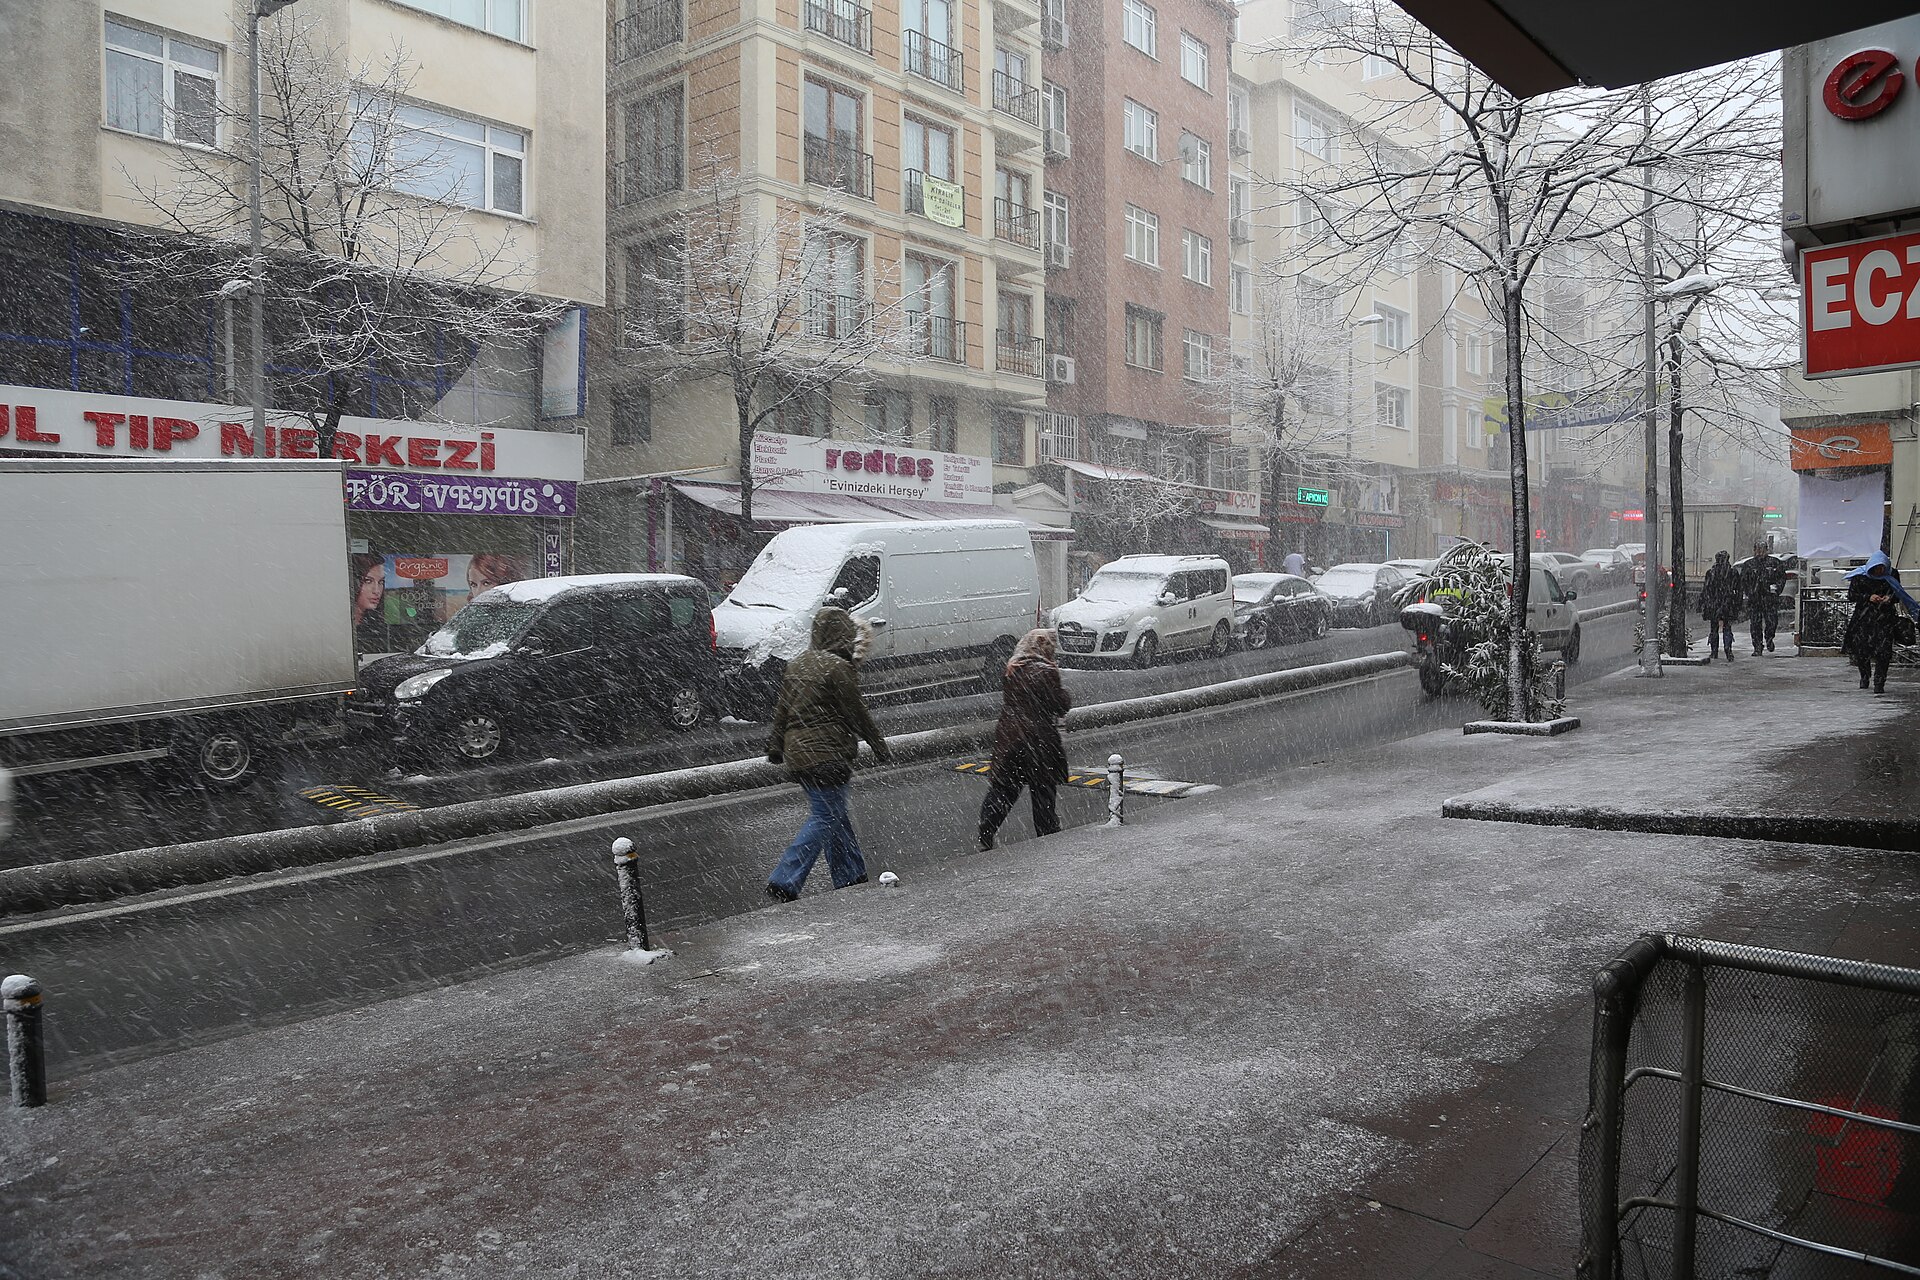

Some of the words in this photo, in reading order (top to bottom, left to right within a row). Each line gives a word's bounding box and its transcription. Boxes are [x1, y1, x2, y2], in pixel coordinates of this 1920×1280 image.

[83, 411, 200, 452] TIP
[220, 422, 496, 471] MERKEZİ
[825, 448, 935, 482] redtaş
[423, 481, 539, 513] VENÜS
[399, 560, 444, 577] organic
